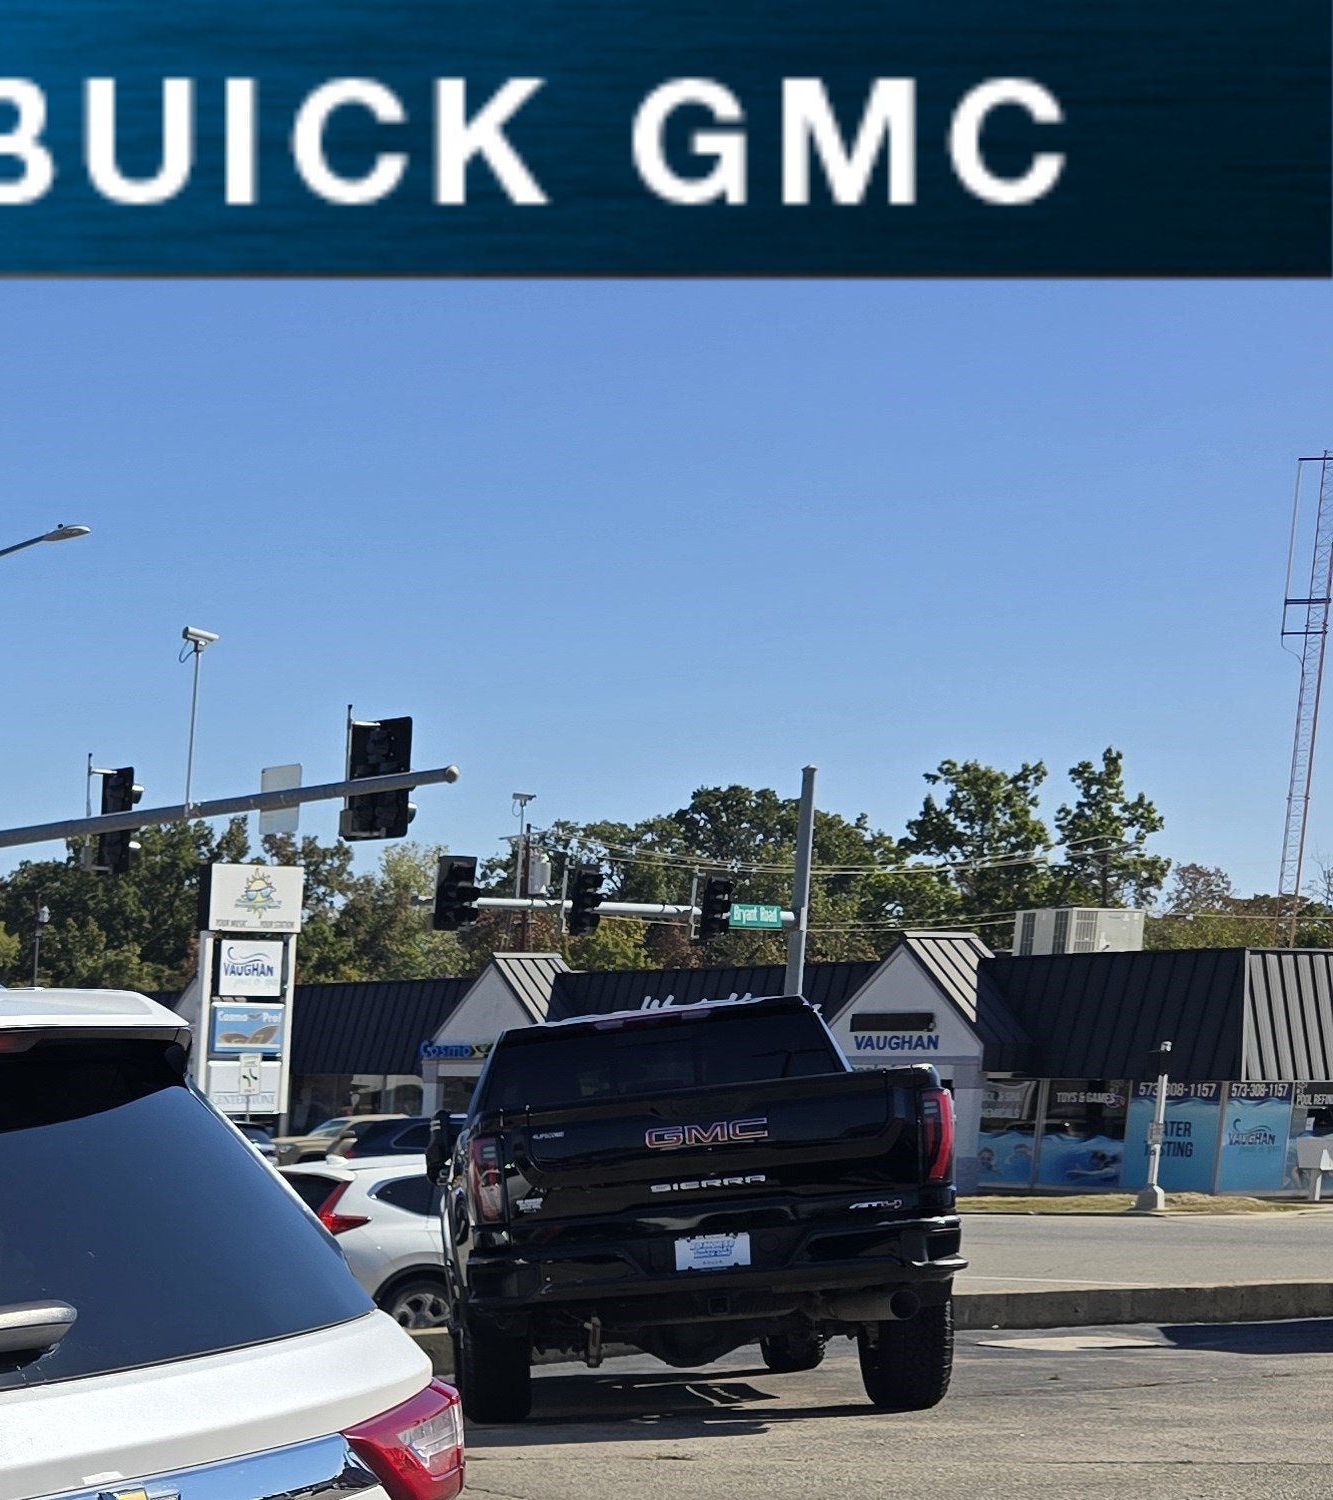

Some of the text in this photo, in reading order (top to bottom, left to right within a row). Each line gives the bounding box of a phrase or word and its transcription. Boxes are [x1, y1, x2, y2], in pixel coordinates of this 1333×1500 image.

[223, 962, 274, 977] VAUGHAN
[854, 1034, 940, 1051] VAUGHAN
[1231, 1083, 1289, 1097] 573-308-1157
[645, 1117, 768, 1149] GMC
[1228, 1131, 1275, 1145] VAUGHAN
[650, 1174, 766, 1193] SIERRA
